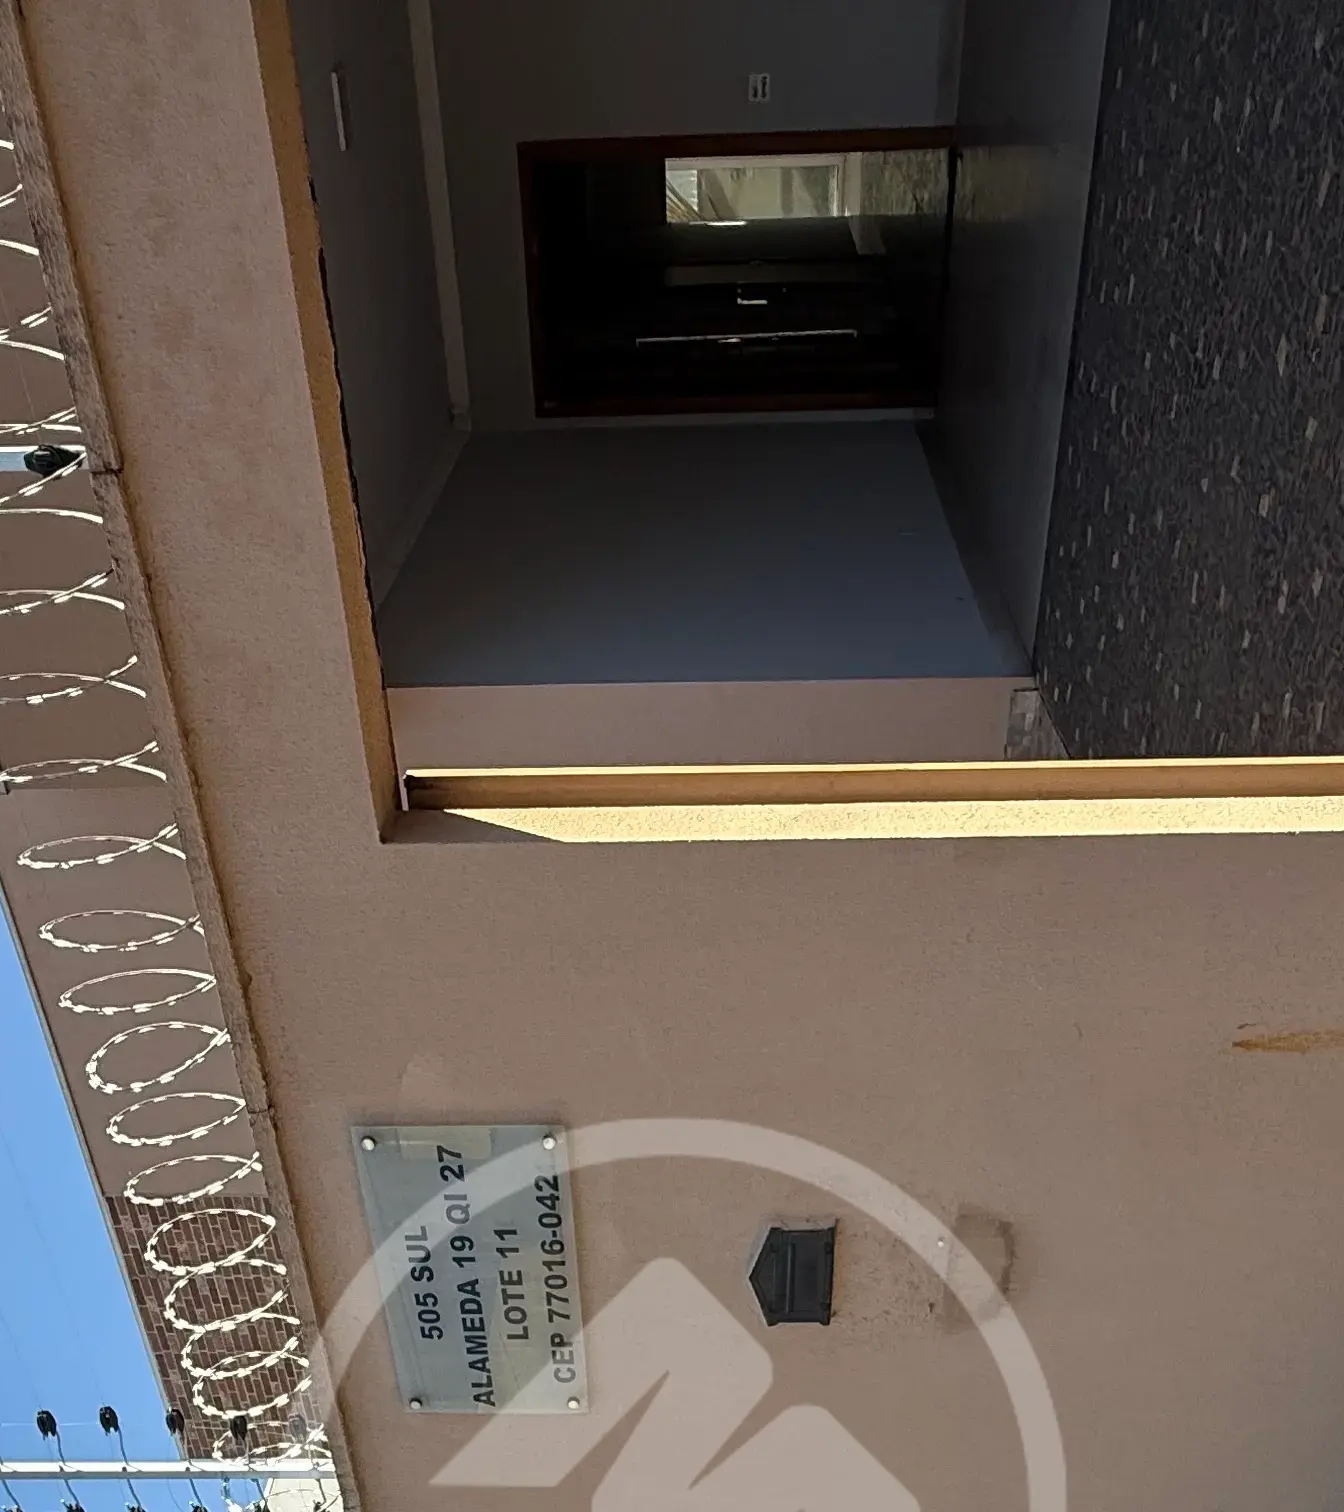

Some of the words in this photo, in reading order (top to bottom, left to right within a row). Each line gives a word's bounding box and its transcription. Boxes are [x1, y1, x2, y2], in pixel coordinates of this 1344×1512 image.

[436, 1144, 465, 1182] 27
[443, 1193, 471, 1225] QI
[404, 1225, 434, 1283] SUL
[449, 1235, 476, 1268] 19
[493, 1229, 520, 1259] 11
[534, 1174, 571, 1323] 77016-042
[414, 1292, 443, 1340] 505
[498, 1269, 529, 1340] LOTE
[457, 1278, 496, 1408] ALAMEDA
[550, 1332, 577, 1384] CEP
